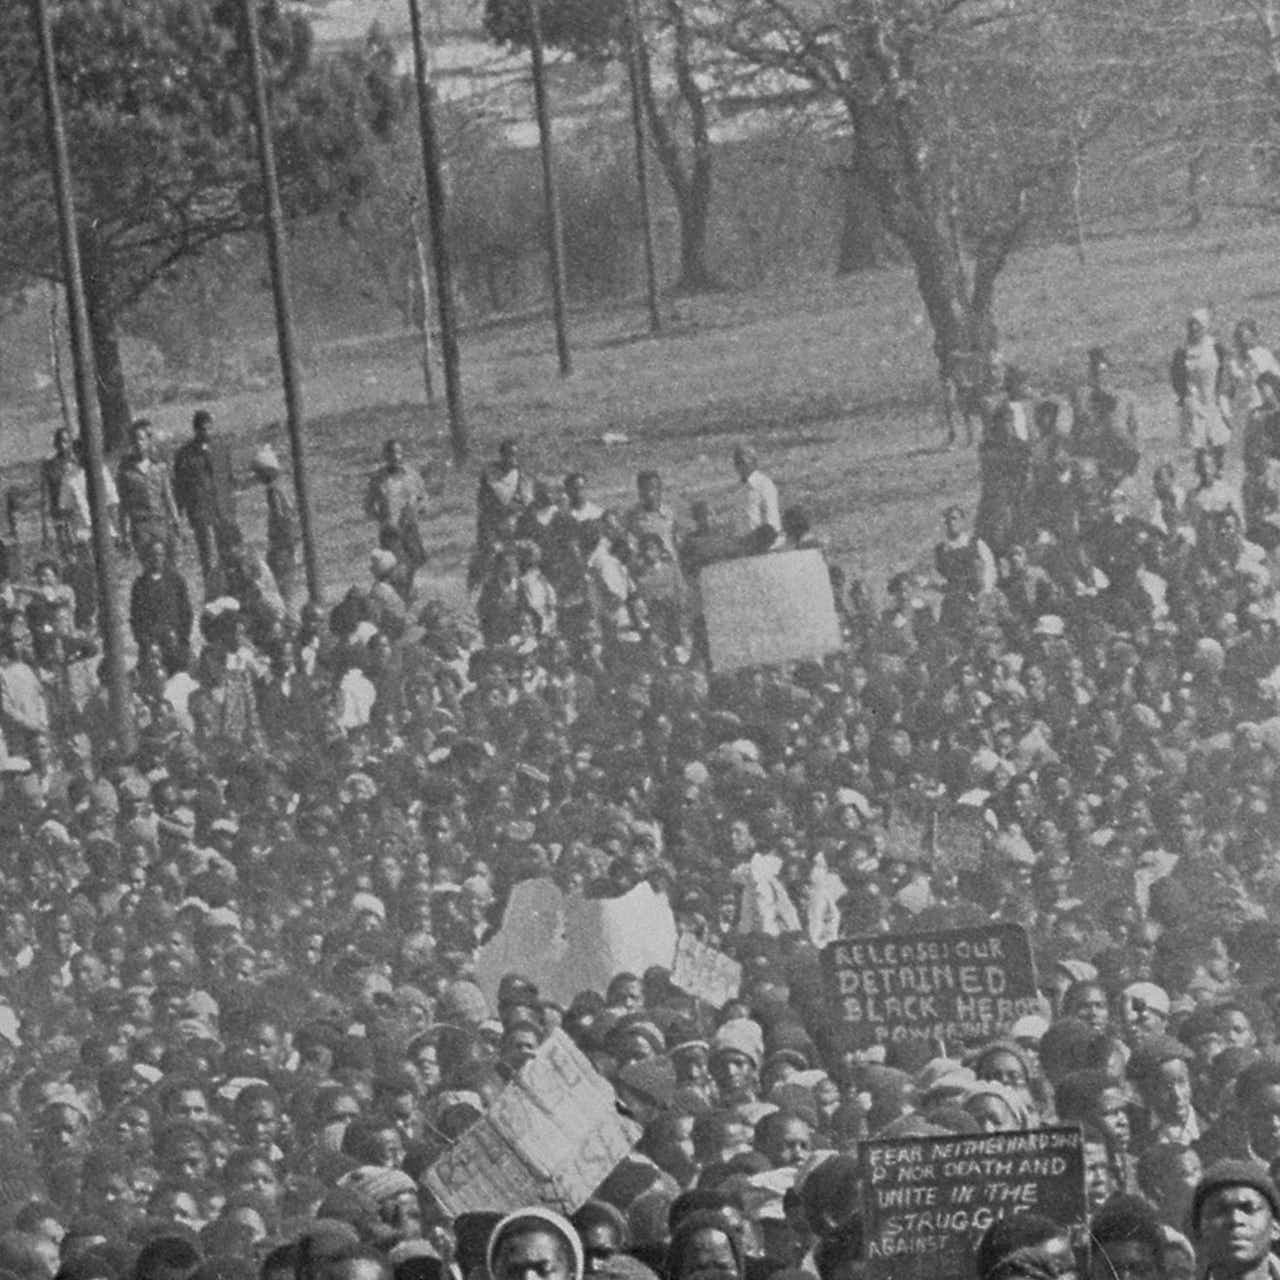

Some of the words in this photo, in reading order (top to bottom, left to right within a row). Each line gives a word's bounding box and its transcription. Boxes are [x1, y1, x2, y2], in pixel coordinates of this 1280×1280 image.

[837, 964, 1006, 995] DETAINED
[843, 996, 938, 1022] BLACK
[870, 1147, 921, 1166] FEAR
[898, 1164, 935, 1182] NOR
[943, 1159, 1013, 1178] DEATH
[1020, 1157, 1067, 1176] AND
[878, 1186, 938, 1209] UNITE
[951, 1185, 977, 1204] IN
[985, 1182, 1039, 1203] THE
